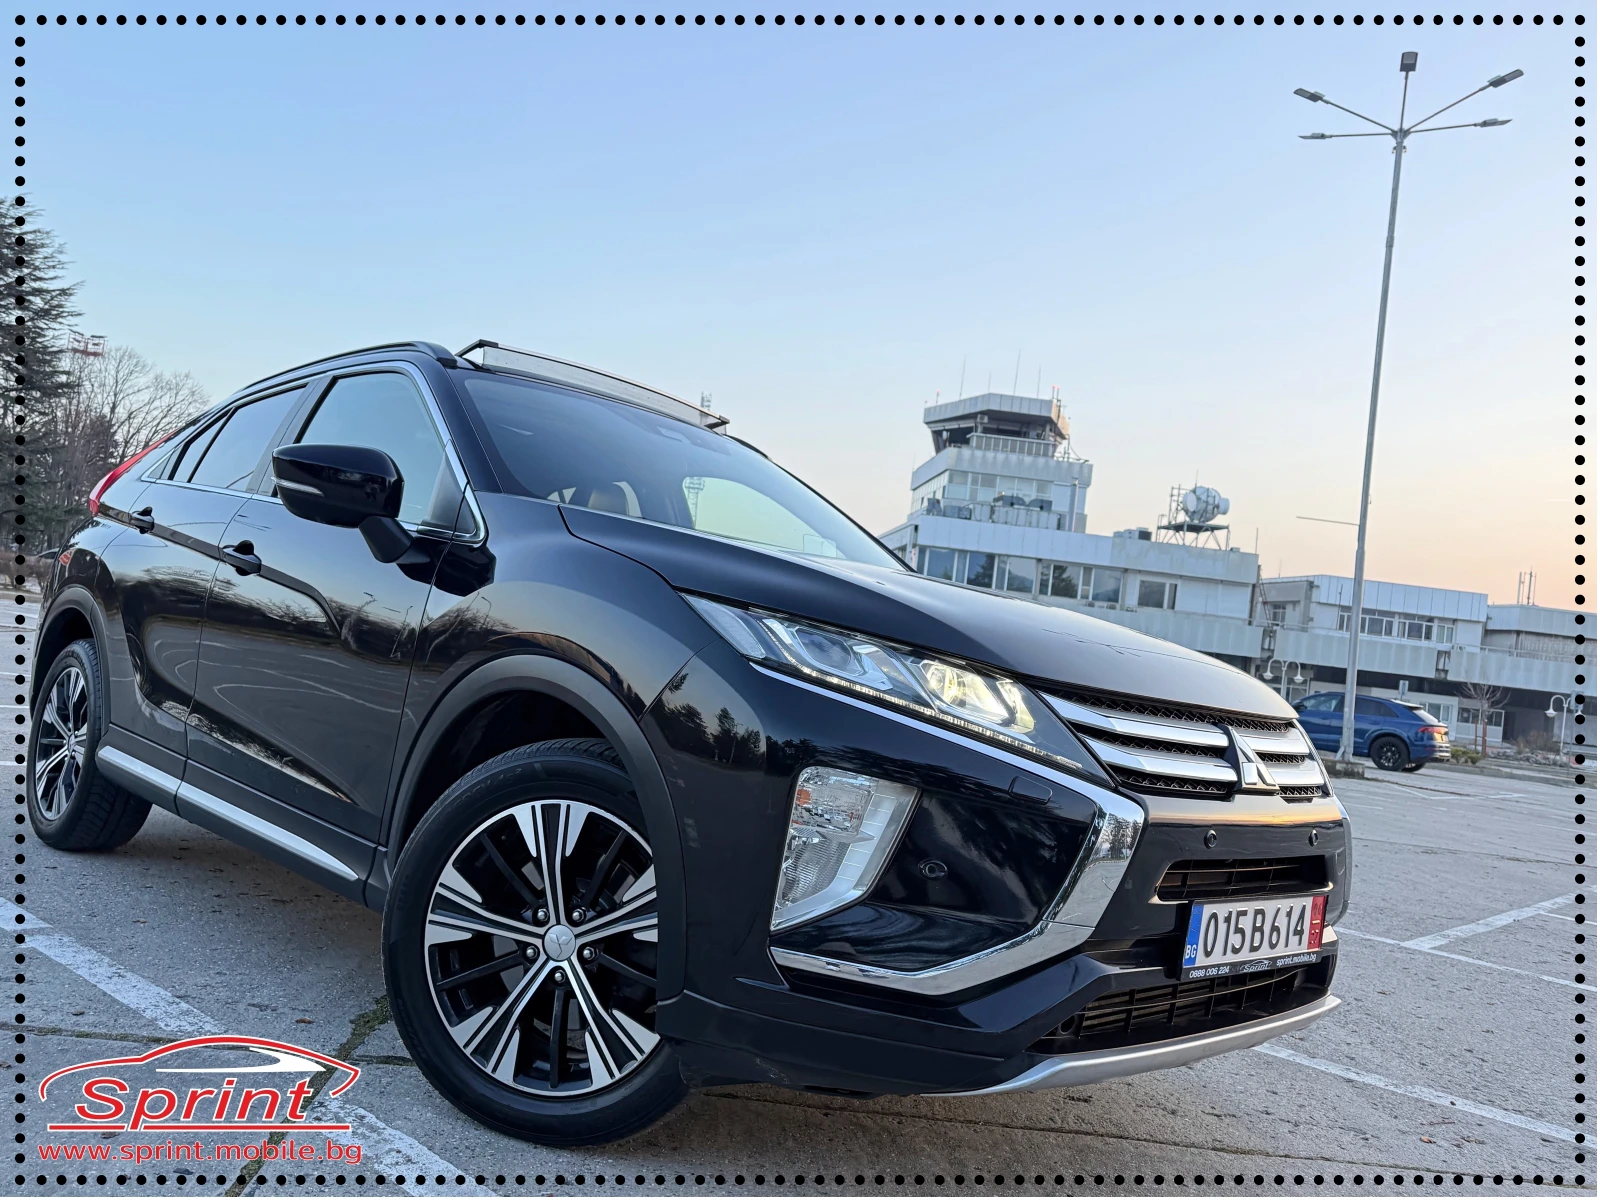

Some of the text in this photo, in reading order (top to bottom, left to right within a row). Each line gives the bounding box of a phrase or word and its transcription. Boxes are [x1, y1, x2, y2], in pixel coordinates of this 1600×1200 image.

[1203, 903, 1307, 958] 015B614
[1185, 944, 1197, 959] BG
[1276, 953, 1317, 968] sprint.mobile.bg
